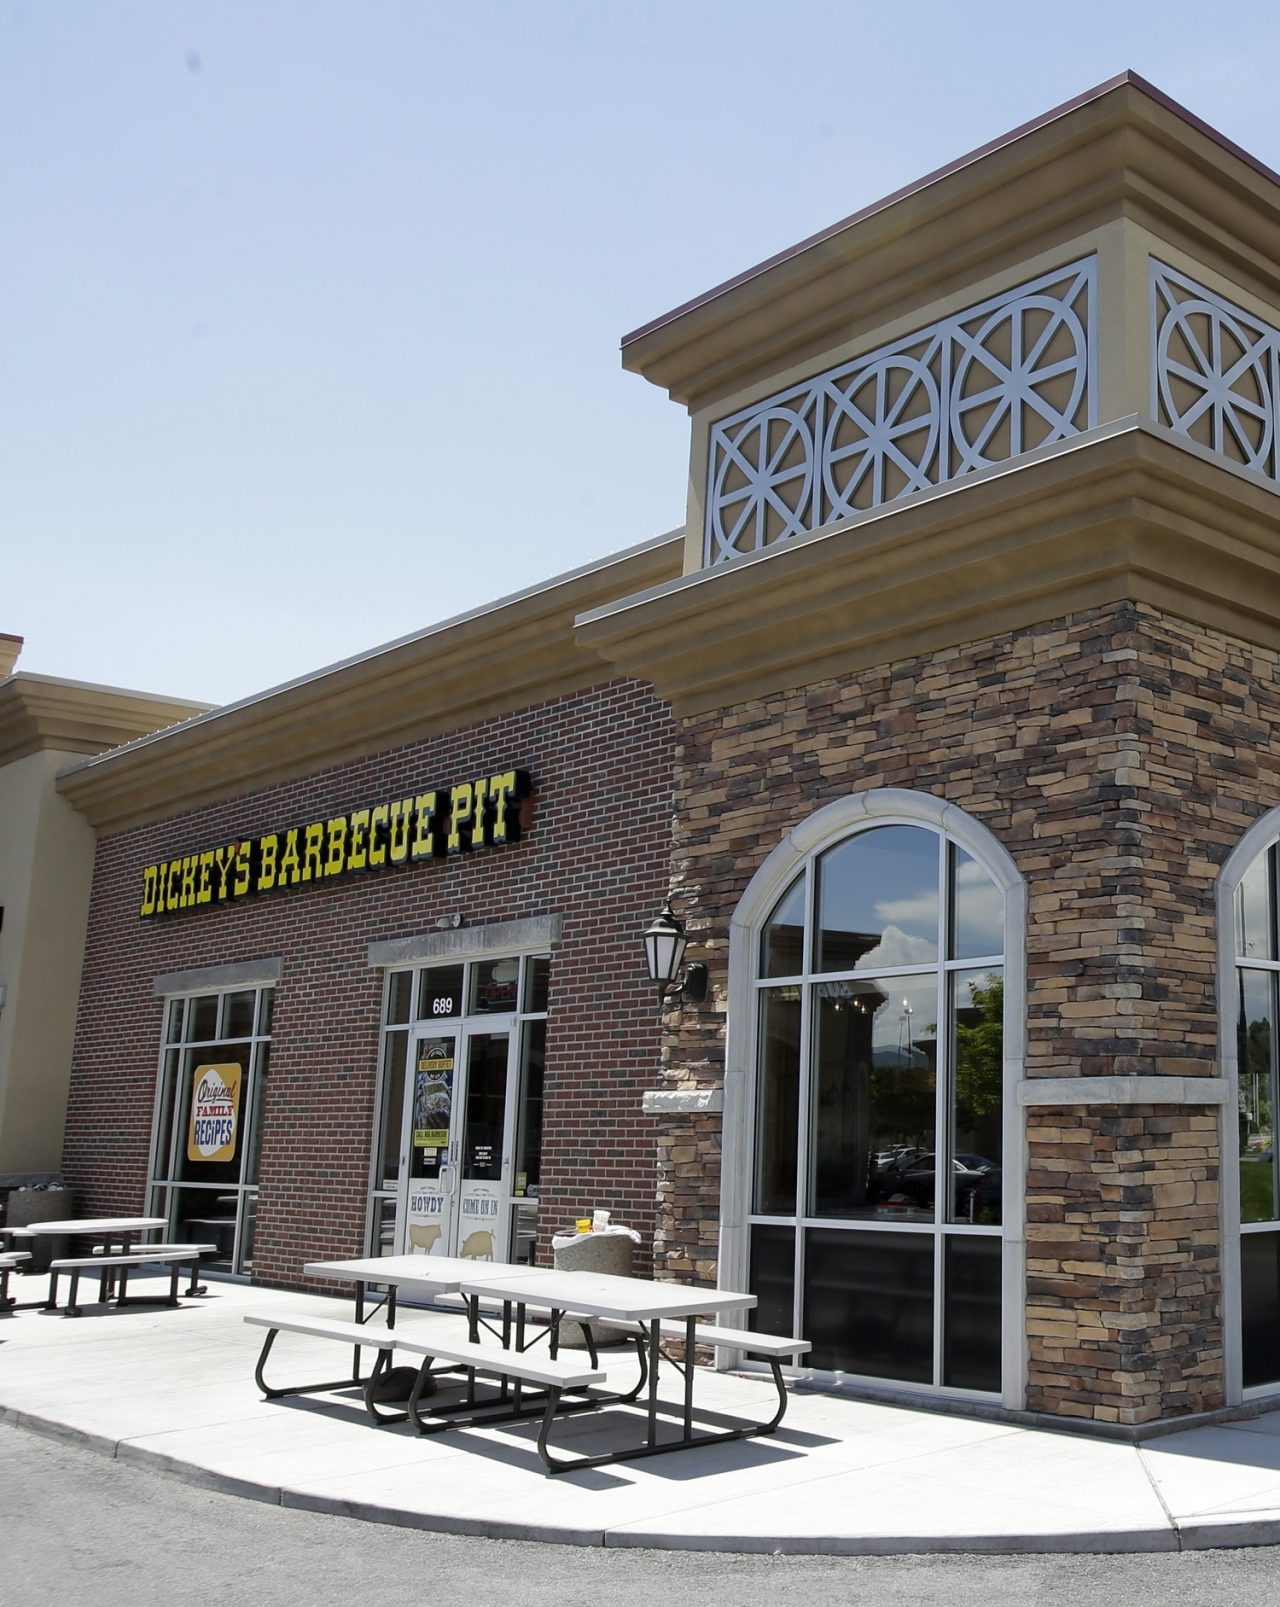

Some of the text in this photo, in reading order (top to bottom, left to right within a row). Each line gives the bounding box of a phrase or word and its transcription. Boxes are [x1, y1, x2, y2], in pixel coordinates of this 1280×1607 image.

[257, 791, 437, 891] BARBECUE
[447, 770, 517, 850] PIT
[432, 997, 452, 1014] 689
[198, 1078, 237, 1104] Original
[196, 1105, 235, 1118] FAMILY
[410, 1195, 444, 1213] HOWDY
[463, 1198, 499, 1216] COME ON IN
